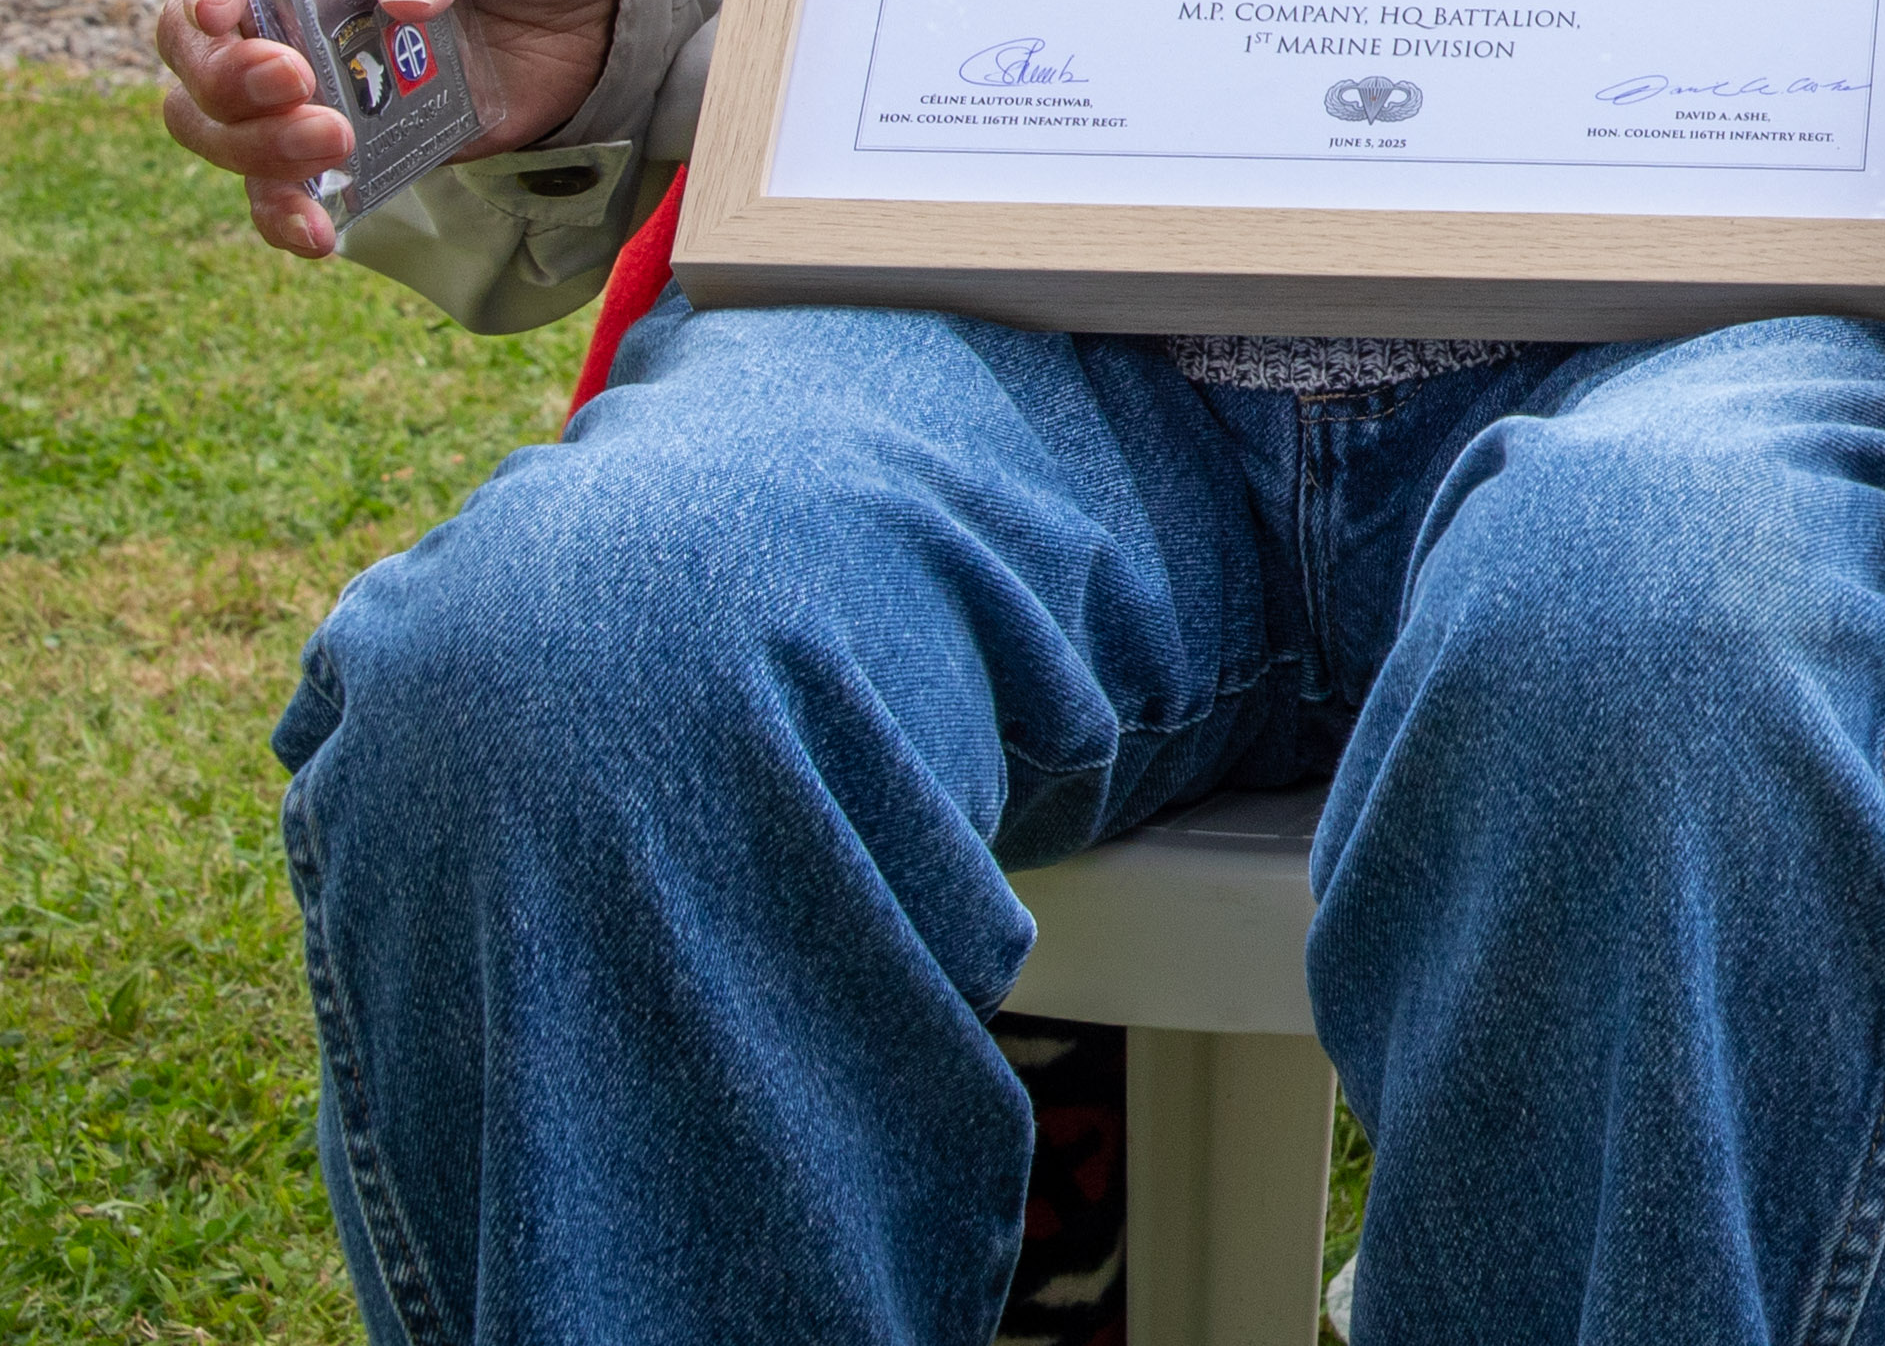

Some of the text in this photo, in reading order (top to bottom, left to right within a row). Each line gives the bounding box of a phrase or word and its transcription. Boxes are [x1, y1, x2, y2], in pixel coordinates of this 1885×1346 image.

[1178, 2, 1581, 30] M.P. COMPANY, HQ BATTALION,
[1276, 36, 1382, 56] MARINE
[1392, 37, 1515, 59] DIVISION
[920, 94, 1094, 110] CÉLINE LAUTOUR SCHWAB,
[879, 113, 1127, 128] HON. COLONEL 116TH INFANTRY REGT.
[1675, 110, 1771, 122] DAVID A. ASHE,
[1329, 137, 1407, 149] JUNE 5, 2025
[1587, 127, 1833, 143] HON. COLONEL 116TH INFANTRY REGT.
